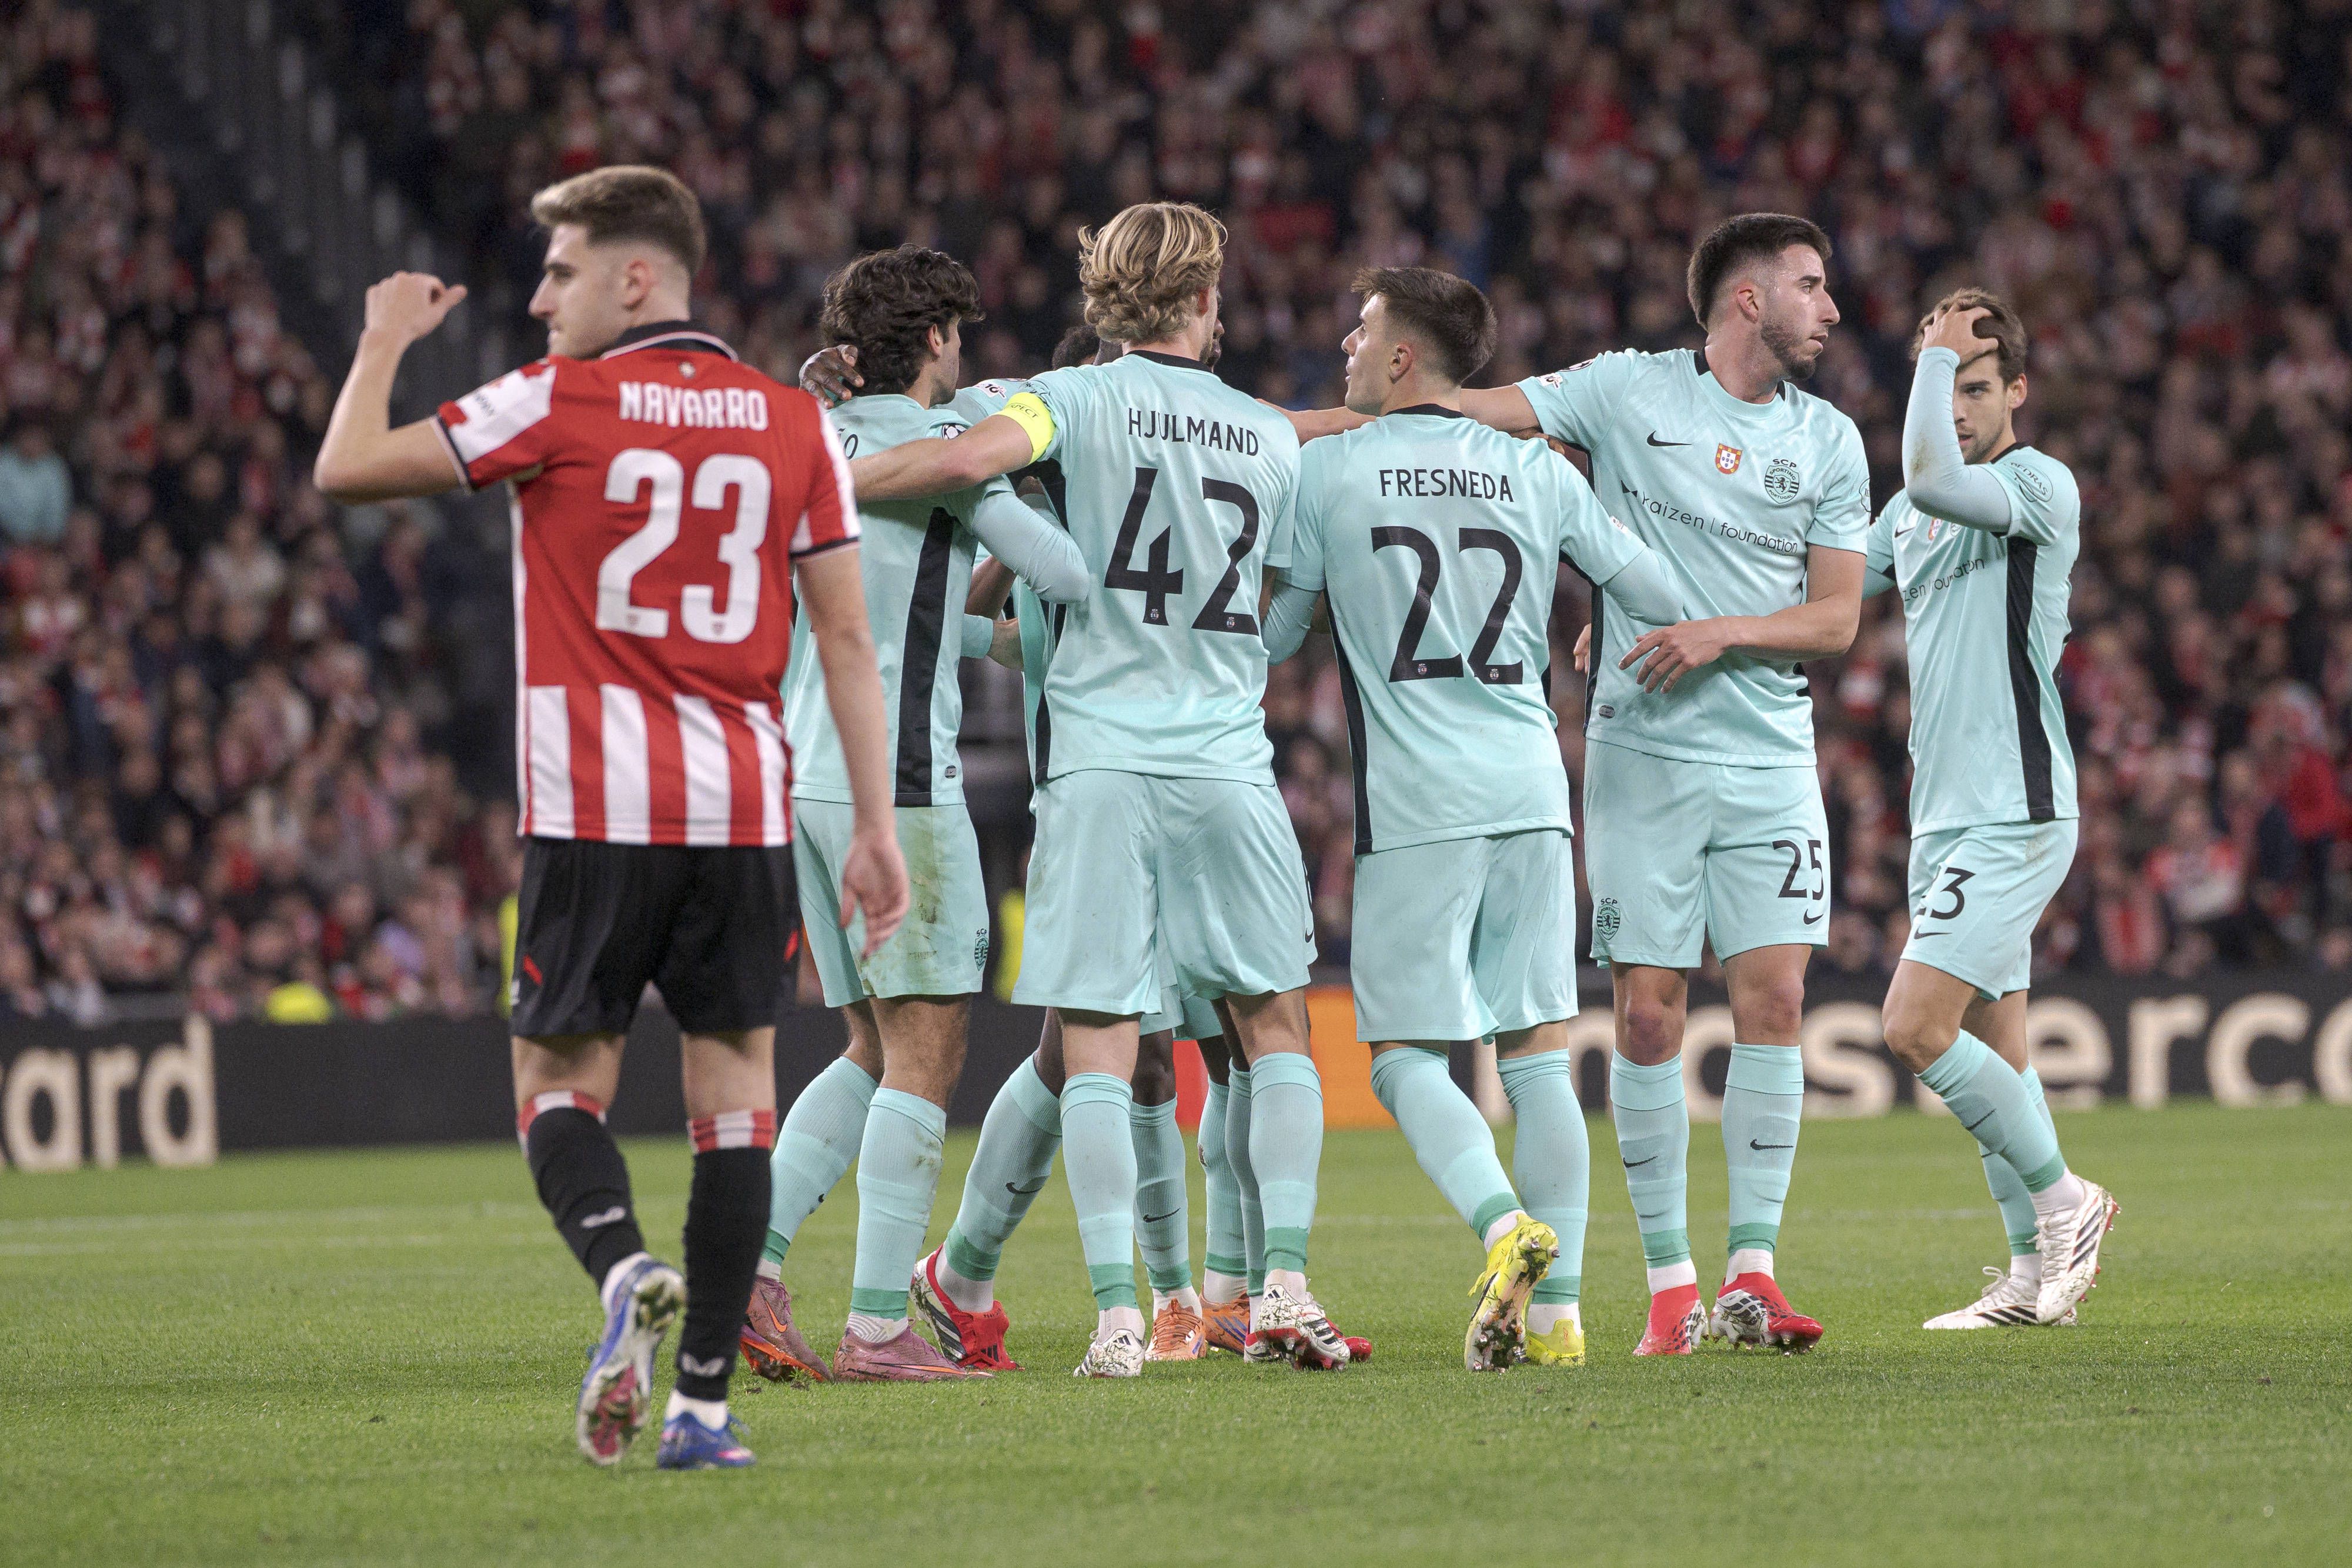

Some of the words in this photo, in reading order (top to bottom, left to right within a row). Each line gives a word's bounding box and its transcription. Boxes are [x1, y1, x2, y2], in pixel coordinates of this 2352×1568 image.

[619, 382, 769, 430] NAVARRO
[1128, 407, 1259, 456] HJULMAND
[1379, 469, 1514, 502] FRESNEDA
[1769, 468, 1796, 480] SPORTING
[1772, 459, 1797, 468] SCP
[1769, 489, 1793, 500] PORTUGAL
[596, 448, 771, 644] 23
[1642, 491, 1705, 530] kaizen
[1720, 522, 1798, 554] foundation
[1104, 467, 1259, 636] 42
[1371, 526, 1523, 685] 22
[1773, 840, 1823, 901] 25
[0, 1012, 219, 1174] ard
